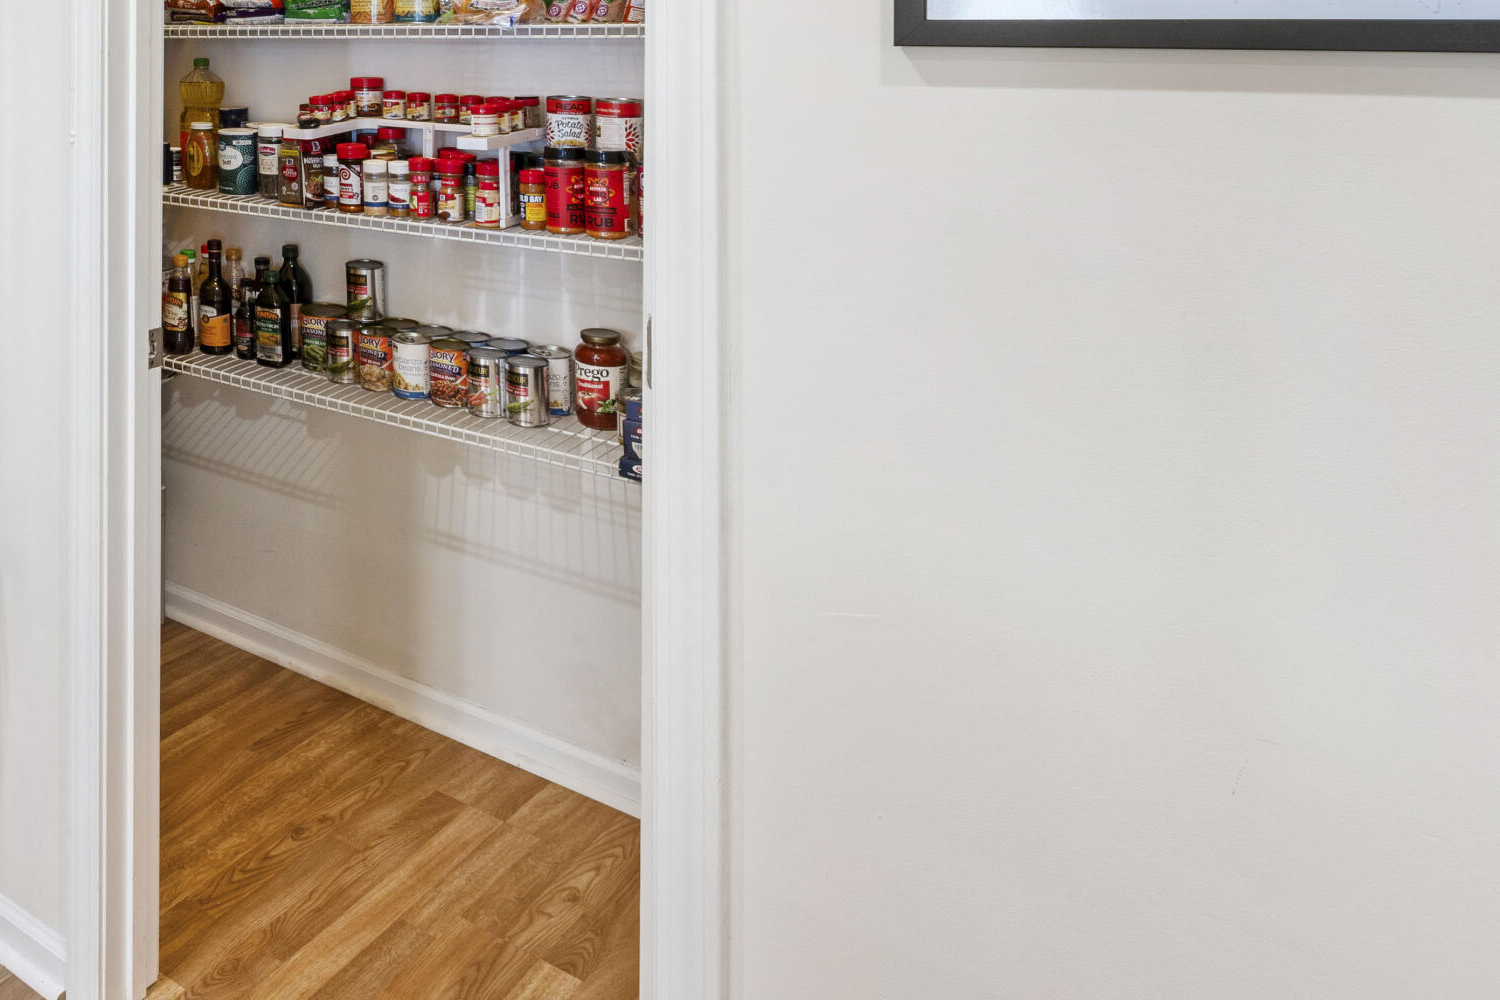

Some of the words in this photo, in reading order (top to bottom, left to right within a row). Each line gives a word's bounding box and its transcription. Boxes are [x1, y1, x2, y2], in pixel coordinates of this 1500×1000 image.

[555, 102, 584, 111] READ
[555, 120, 584, 130] Potato
[558, 128, 582, 139] Salad
